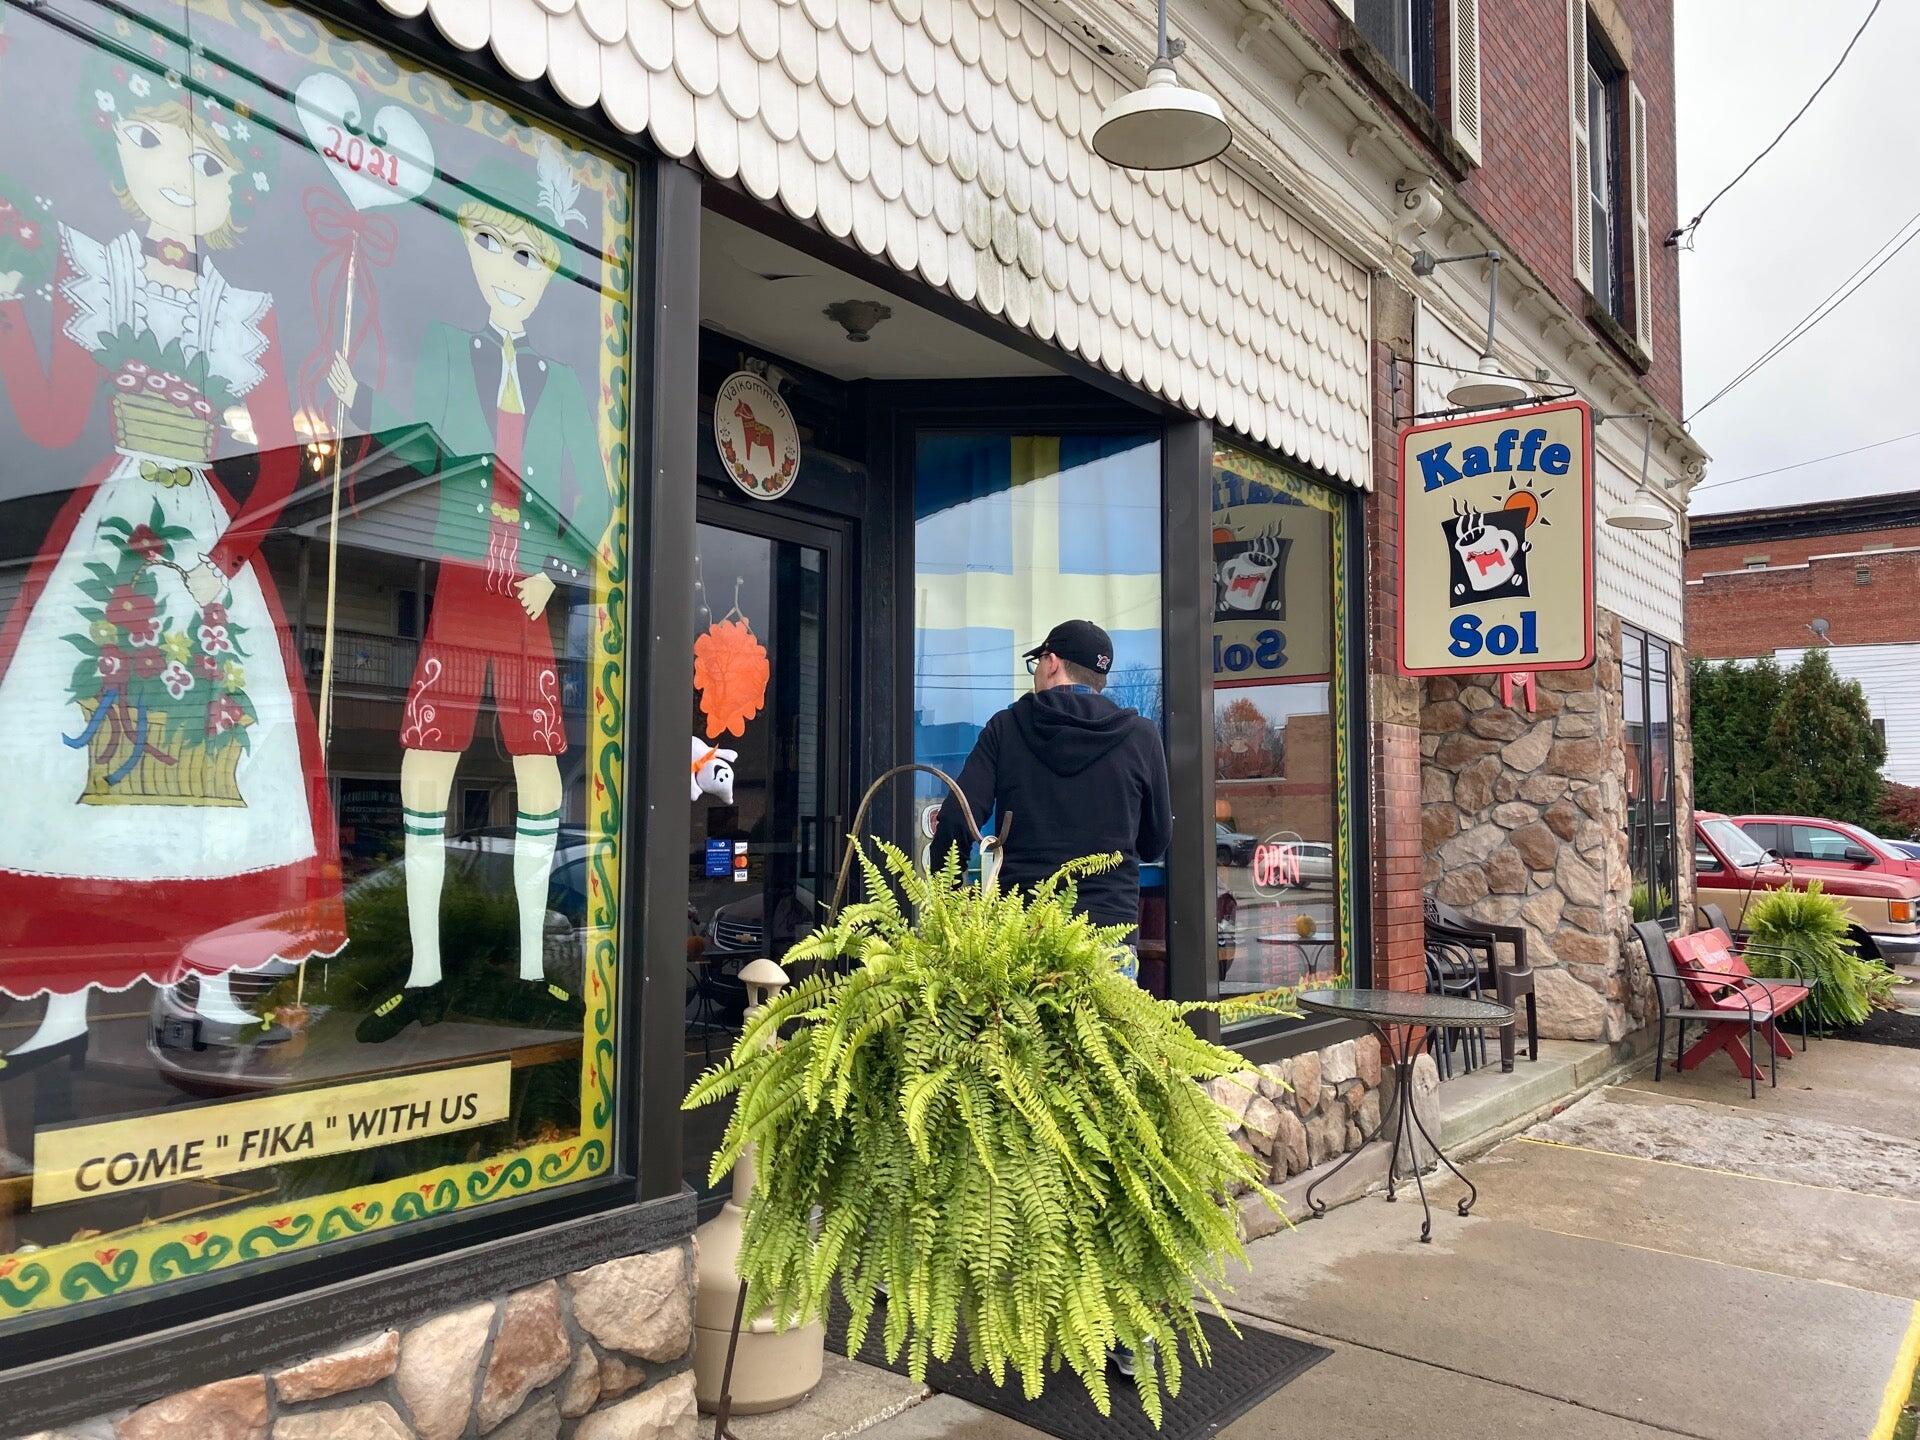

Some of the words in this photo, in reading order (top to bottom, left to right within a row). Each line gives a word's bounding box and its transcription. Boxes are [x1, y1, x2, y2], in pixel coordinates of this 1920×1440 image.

[323, 127, 399, 186] 2021
[1416, 429, 1571, 493] Kaffe
[1448, 611, 1539, 657] Sol
[1253, 844, 1300, 887] OPEN
[74, 1140, 204, 1192] COME
[238, 1121, 315, 1162] FIKA
[347, 1100, 431, 1142] WITH
[439, 1092, 479, 1124] US
